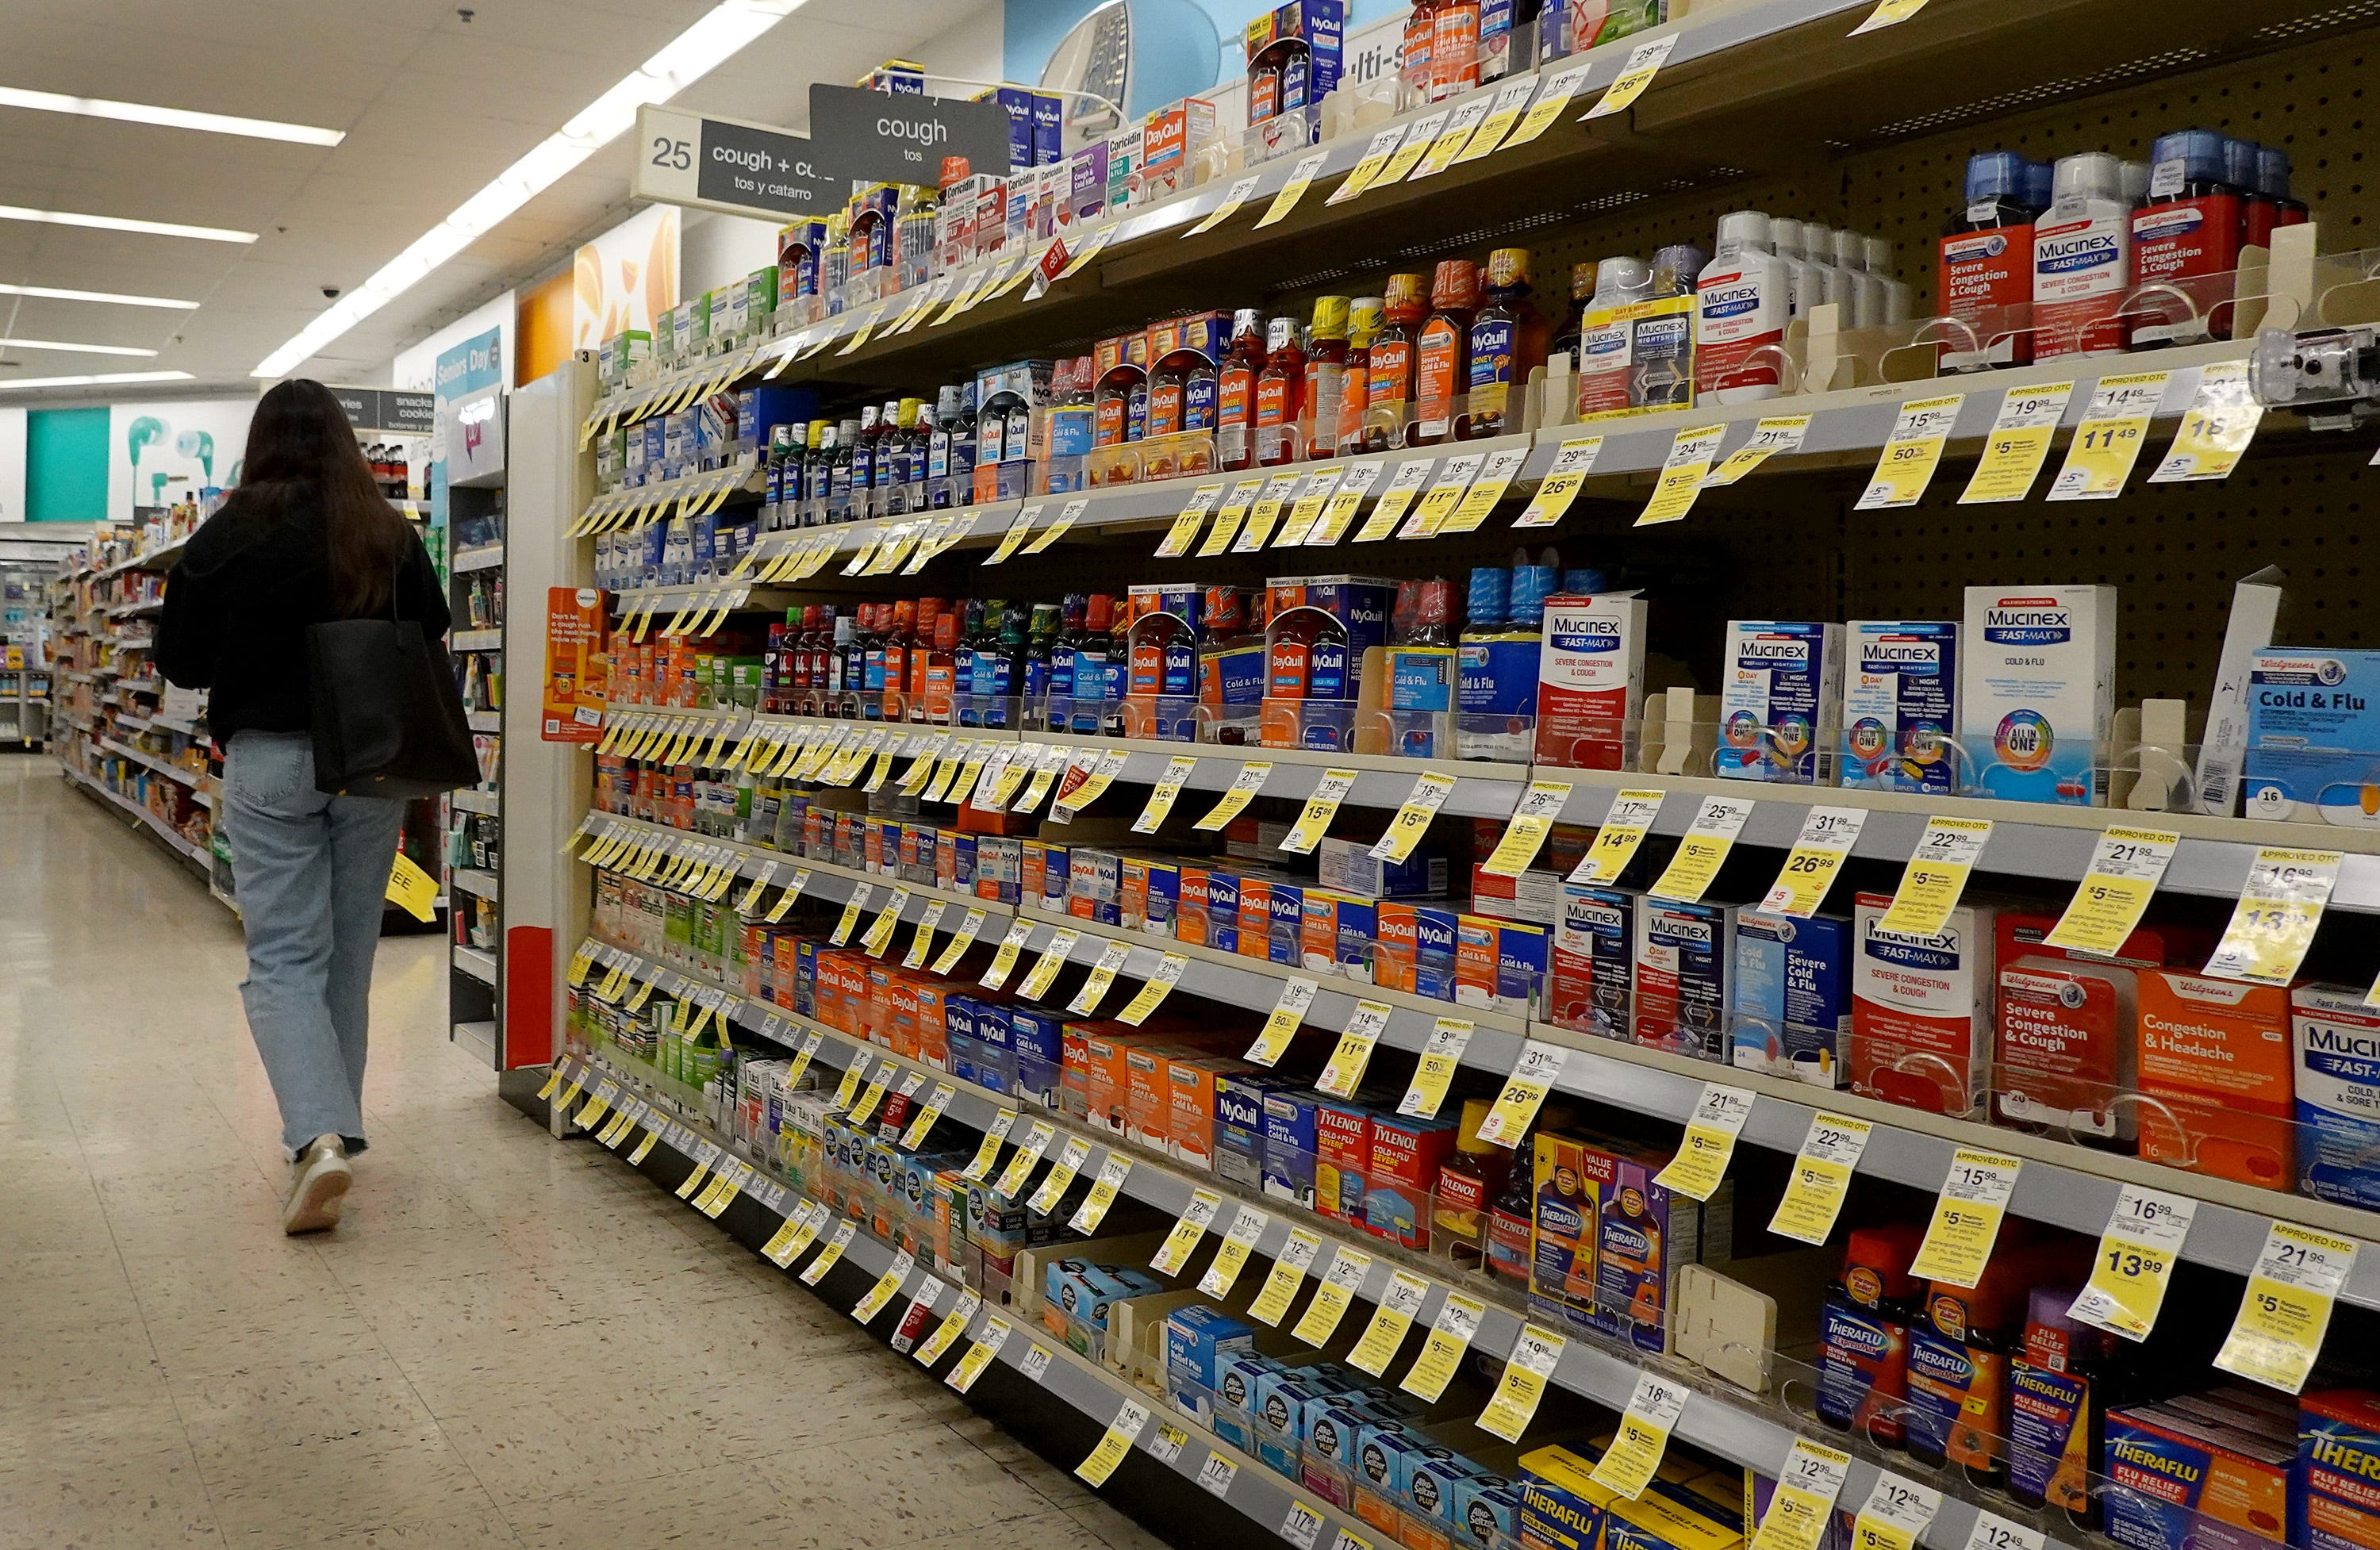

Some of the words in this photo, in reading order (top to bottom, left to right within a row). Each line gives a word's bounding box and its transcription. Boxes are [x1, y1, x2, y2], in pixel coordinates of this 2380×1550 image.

[1311, 17, 1341, 33] NyQuil
[895, 82, 921, 94] NyQuil
[1035, 111, 1060, 123] NyQuil
[877, 118, 947, 145] cough
[1146, 119, 1183, 145] DayQuil
[1110, 132, 1142, 152] Coricidin
[651, 137, 692, 170] 25
[713, 146, 772, 171] cough
[904, 148, 922, 161] tos
[1041, 165, 1064, 180] Coricidin
[735, 175, 754, 190] tos
[758, 182, 765, 195] y
[768, 182, 812, 200] catarro
[947, 178, 975, 198] Coricidin
[1008, 172, 1035, 190] Coricidin
[2040, 236, 2114, 259] Mucinex
[2141, 243, 2175, 255] Severe
[2141, 247, 2202, 263] Congestion
[1951, 264, 1983, 275] Severe
[2053, 255, 2101, 270] FAST-MAX
[2141, 264, 2149, 273] &
[2152, 259, 2184, 273] Cough
[1951, 270, 2007, 286] Congestion
[2041, 278, 2068, 289] SEVERE
[2071, 272, 2110, 286] CONGESTION
[1706, 287, 1756, 305] Mucinex
[1950, 286, 1959, 296] &
[1960, 283, 1990, 296] Cough
[1639, 320, 1684, 335] Mucinex
[1472, 331, 1507, 350] NyQuil
[1587, 331, 1625, 343] Mucinex
[582, 351, 589, 363] 3
[1379, 351, 1406, 367] DayQuil
[437, 359, 466, 386] Seniors
[470, 349, 489, 371] Day
[1220, 381, 1246, 395] DayQuil
[2100, 377, 2146, 386] APPROVED
[1187, 387, 1211, 401] NyQuil
[1258, 387, 1283, 400] DayQuil
[2010, 386, 2053, 397] APPROVED
[2055, 384, 2071, 393] OTC
[396, 397, 432, 408] snacks
[1151, 393, 1177, 406] DayQuil
[1760, 418, 1792, 427] APPROVED
[1794, 417, 1806, 426] OTC
[1351, 609, 1383, 622] NyQuil
[1988, 610, 2067, 626] Mucinex
[1554, 618, 1618, 633] Mucinex
[1564, 638, 1606, 648] FAST-MAX
[2002, 631, 2052, 640] FAST-MAX
[1741, 643, 1805, 657] Mucinex
[1864, 645, 1935, 661] Mucinex
[1134, 655, 1157, 668] DayQuil
[1166, 654, 1189, 669] NyQuil
[1273, 655, 1303, 668] DayQuil
[1313, 654, 1342, 669] NyQuil
[1555, 658, 1576, 667] SEVERE
[1578, 659, 1613, 668] CONGESTION
[2260, 659, 2315, 670] Walgreens
[2259, 691, 2305, 708] Cold
[2310, 693, 2327, 708] &
[2332, 692, 2365, 710] Flu
[2010, 738, 2036, 750] ONE
[2263, 792, 2277, 802] 16
[1931, 818, 1971, 829] APPROVED
[1972, 822, 1989, 831] OTC
[2109, 828, 2155, 841] APPROVED
[2157, 834, 2177, 843] OTC
[1181, 884, 1207, 897] DayQuil
[1209, 889, 1235, 904] NyQuil
[1241, 896, 1269, 911] DayQuil
[1271, 902, 1299, 916] NyQuil
[1568, 905, 1619, 924] Mucinex
[1380, 920, 1415, 937] DayQuil
[1418, 927, 1451, 945] NyQuil
[1652, 918, 1708, 939] Mucinex
[1788, 955, 1826, 970] Severe
[1883, 946, 1937, 965] FAST-MAX
[1788, 966, 1813, 979] Cold
[1871, 969, 1899, 983] SEVERE
[1901, 973, 1950, 991] CONGESTION
[1787, 978, 1797, 988] &
[1798, 978, 1816, 991] Flu
[2007, 974, 2058, 990] Walgreens
[2180, 982, 2234, 997] Walgreens
[2006, 1002, 2056, 1021] Severe
[949, 1015, 973, 1034] NyQuil
[981, 1023, 1005, 1042] NyQuil
[2006, 1017, 2088, 1041] Congestion
[2144, 1015, 2226, 1040] Congestion
[2006, 1030, 2017, 1042] &
[2019, 1032, 2066, 1052] Cough
[2145, 1032, 2157, 1048] &
[2161, 1038, 2234, 1061] Headache
[2309, 1026, 2380, 1057] Muci
[1220, 1099, 1257, 1126] NyQuil
[1269, 1122, 1288, 1134] Severe
[1320, 1110, 1362, 1134] TYLENOL
[1319, 1138, 1343, 1149] SEVERE
[1374, 1125, 1417, 1151] TYLENOL
[1373, 1154, 1399, 1166] SEVERE
[1586, 1153, 1612, 1170] VALUE
[1588, 1164, 1610, 1180] PACK
[1441, 1175, 1476, 1196] TYLENOL
[1541, 1207, 1578, 1226] THERAFLU
[1604, 1227, 1645, 1248] THERAFLU
[2274, 1224, 2328, 1246] APPROVED
[2331, 1239, 2352, 1253] OTC
[1829, 1318, 1882, 1346] THERAFLU
[2039, 1328, 2056, 1340] FLU
[1171, 1340, 1184, 1352] Cold
[2031, 1335, 2064, 1351] RELIEF
[1913, 1344, 1967, 1374] THERAFLU
[2014, 1372, 2076, 1403] THERAFLU
[2115, 1438, 2198, 1482] THERAFLU
[2117, 1466, 2137, 1480] FLU
[2140, 1474, 2182, 1493] RELIEF
[1523, 1481, 1593, 1535] THERAFLU
